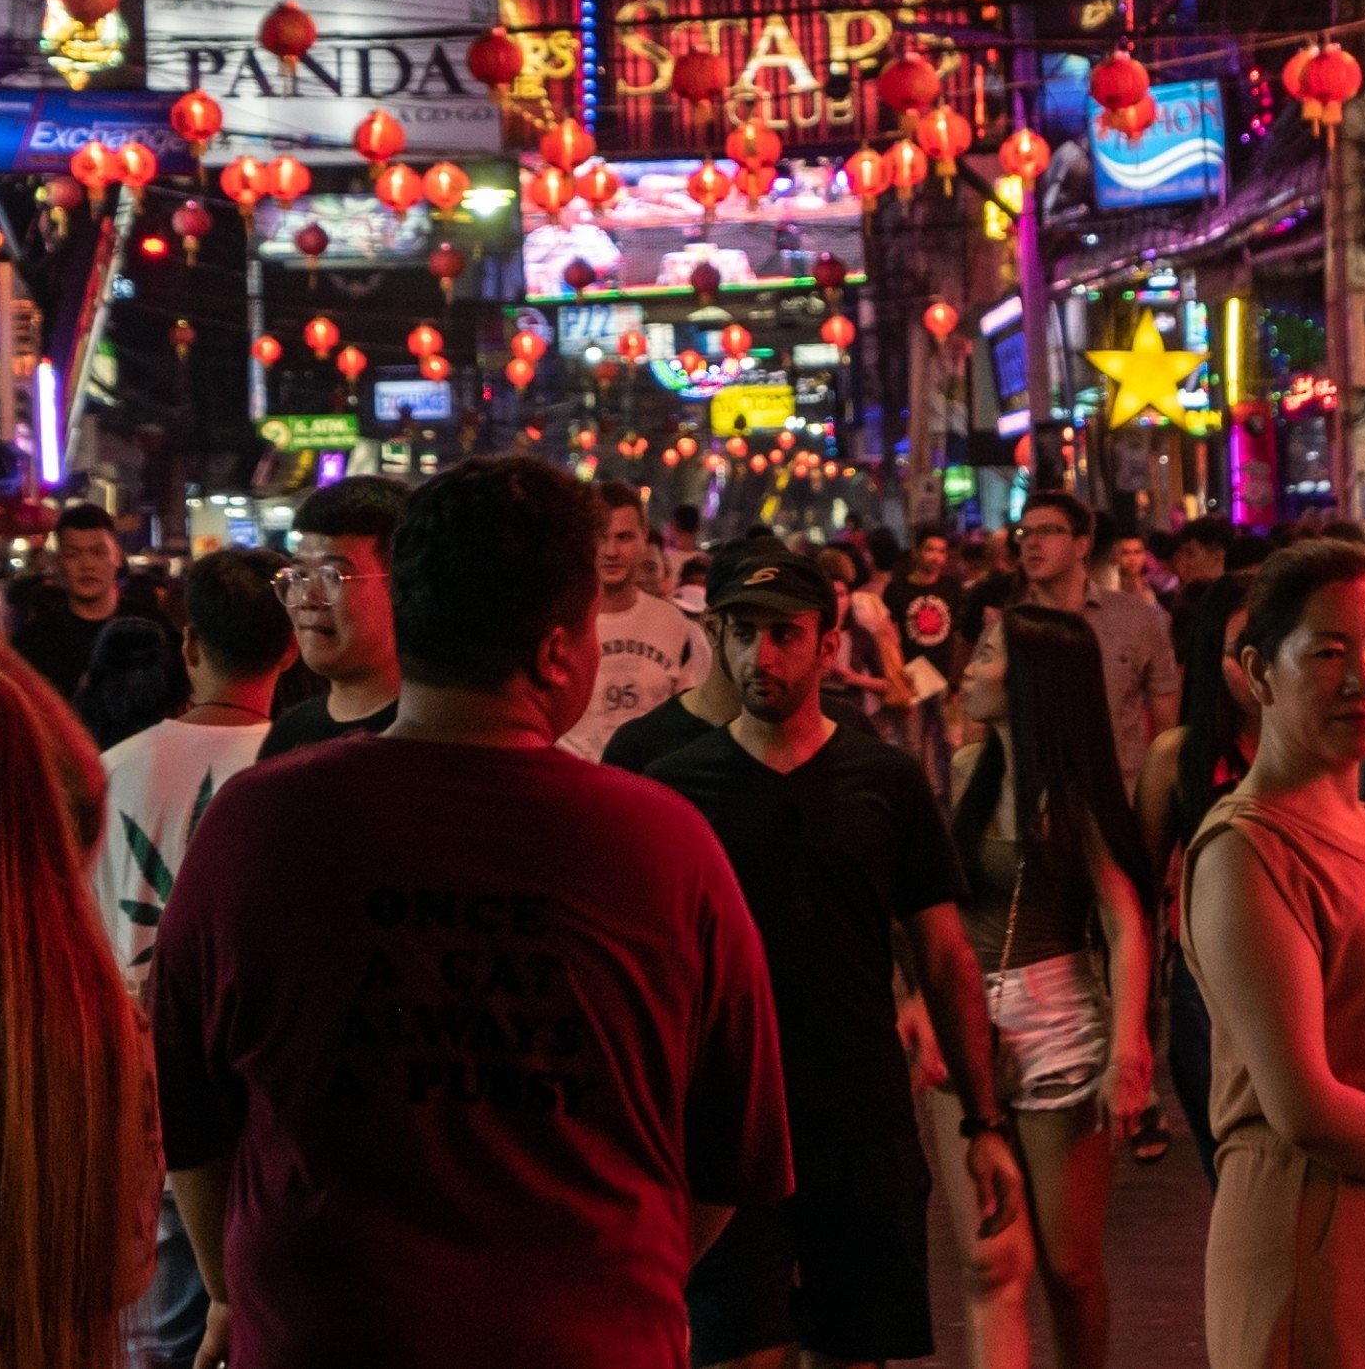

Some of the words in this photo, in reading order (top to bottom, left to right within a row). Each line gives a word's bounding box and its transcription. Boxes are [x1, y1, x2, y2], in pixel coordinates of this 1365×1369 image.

[184, 45, 469, 99] PANDA
[725, 86, 855, 129] CLUB
[364, 885, 551, 939] ONCE
[361, 946, 403, 992] A
[440, 950, 565, 998] CAT
[339, 1003, 585, 1059] ALWAYS
